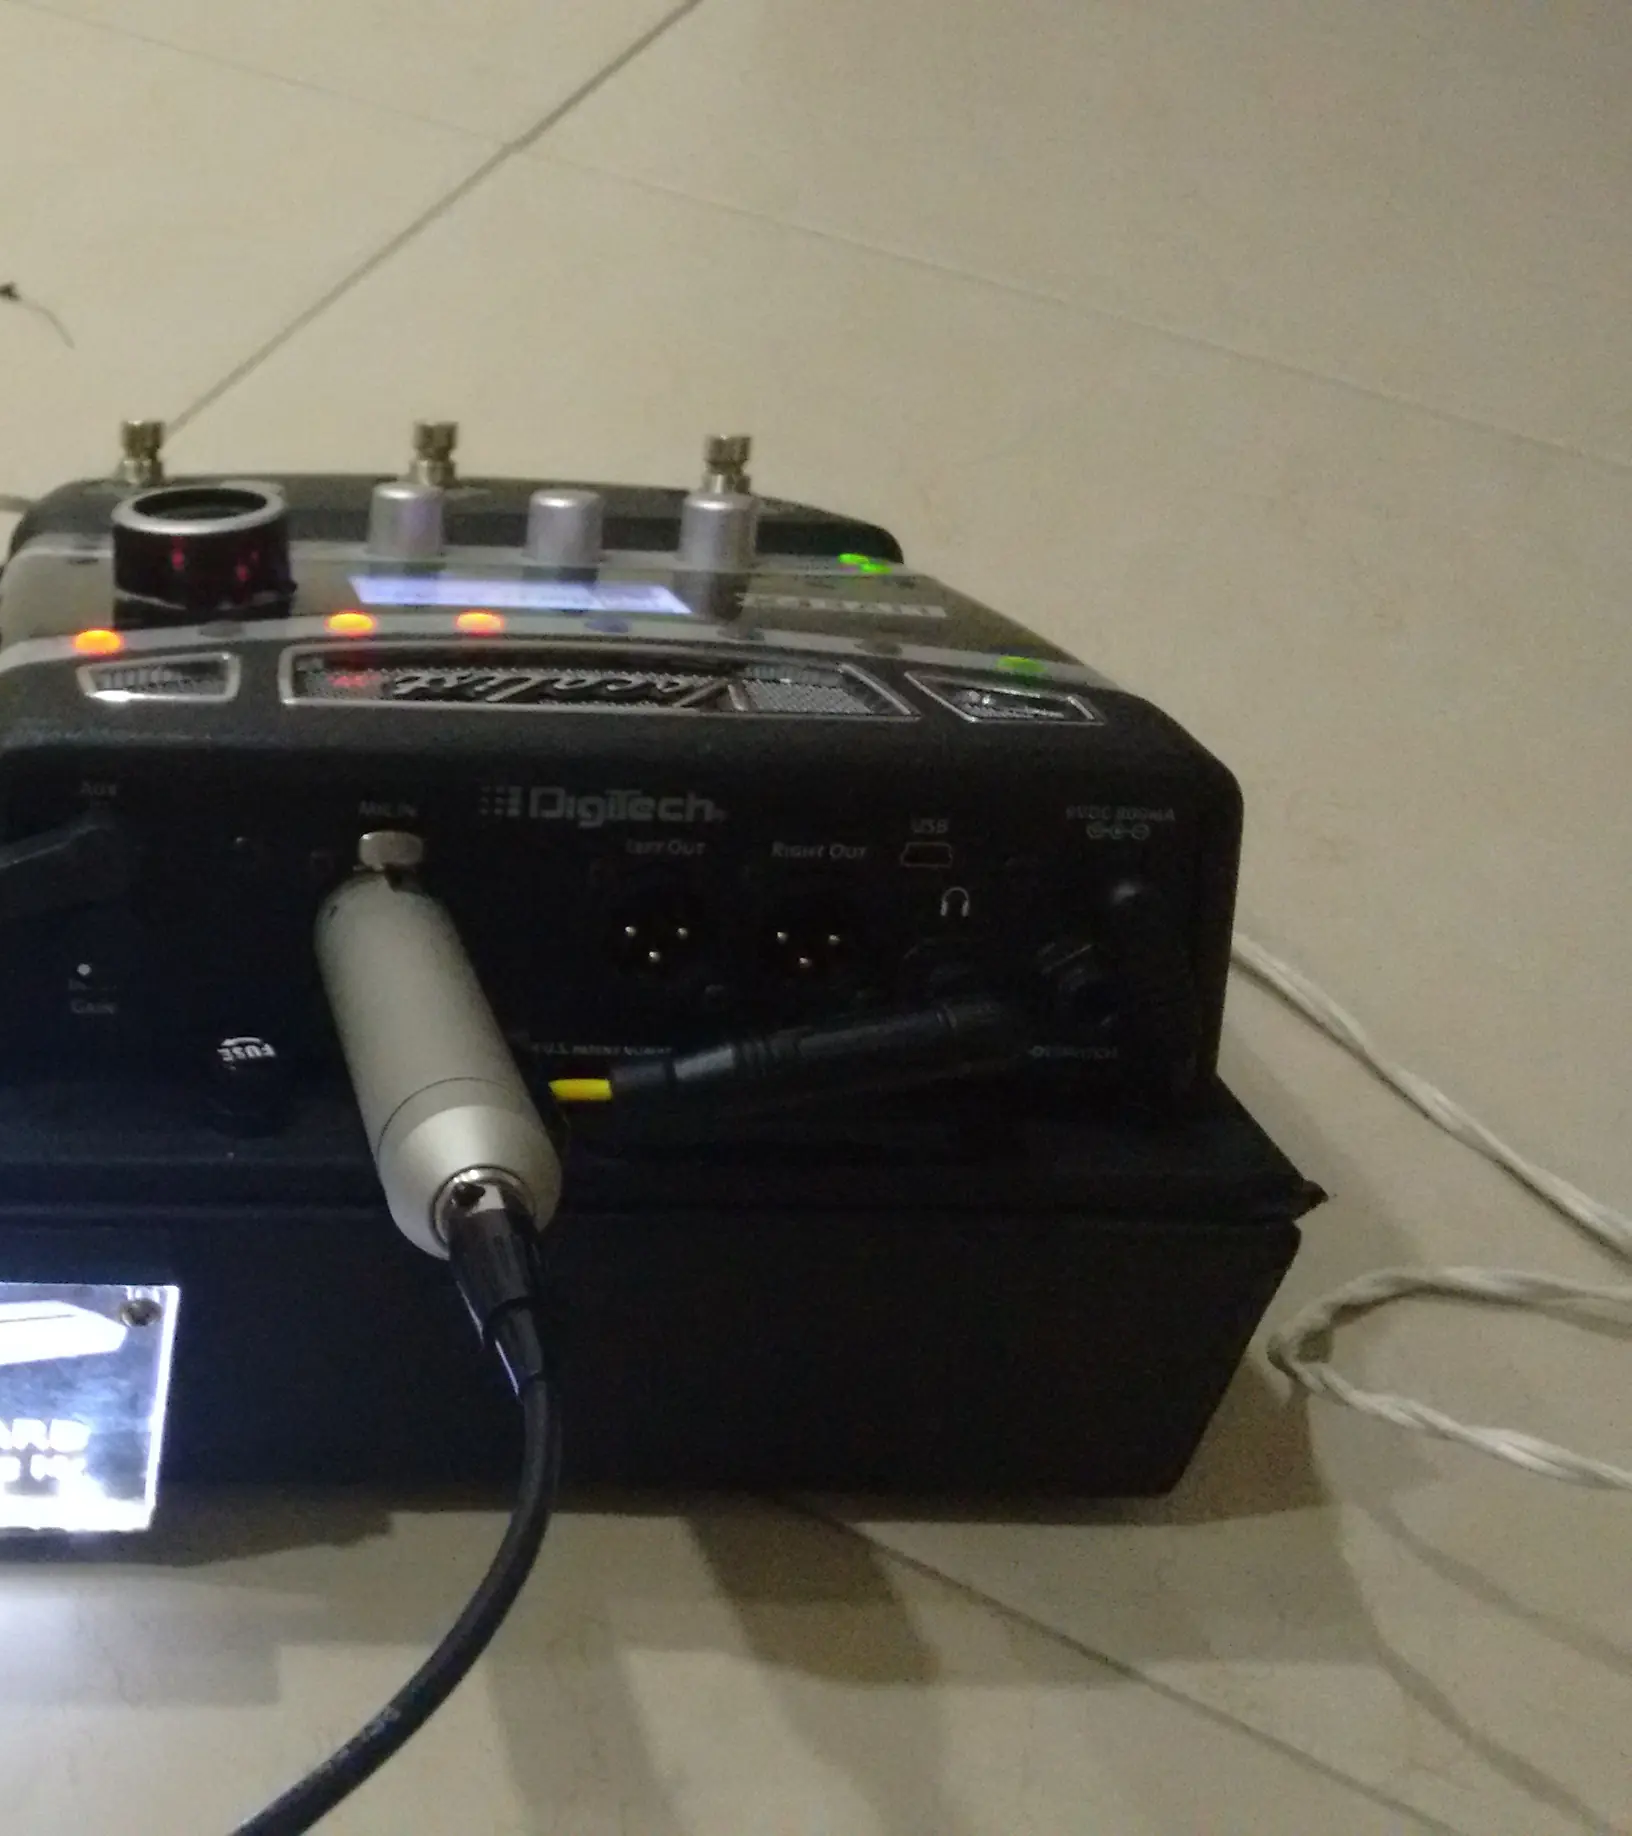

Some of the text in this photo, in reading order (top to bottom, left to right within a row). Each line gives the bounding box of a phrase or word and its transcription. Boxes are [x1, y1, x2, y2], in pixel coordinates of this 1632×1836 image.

[529, 786, 716, 828] DigiTech
[910, 818, 949, 834] USB
[216, 1042, 277, 1063] FUSE
